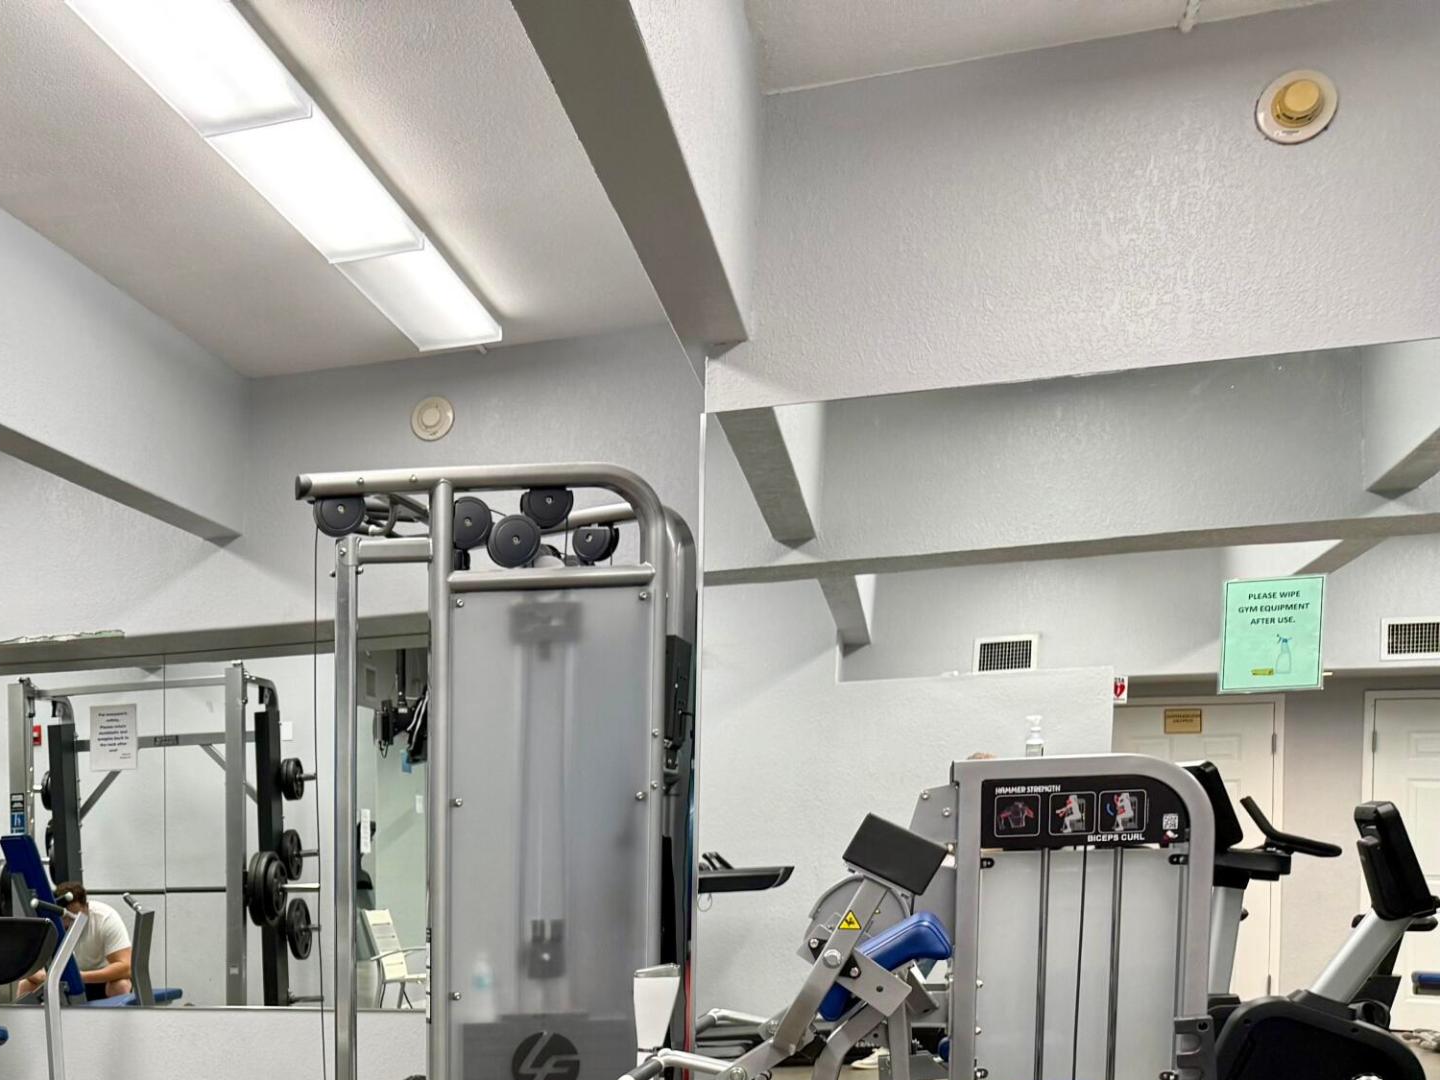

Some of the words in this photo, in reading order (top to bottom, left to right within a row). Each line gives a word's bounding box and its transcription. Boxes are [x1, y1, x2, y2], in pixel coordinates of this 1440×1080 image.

[1248, 592, 1277, 600] PLEASE
[1279, 590, 1300, 598] WIPE
[1238, 605, 1258, 613] GYM
[1260, 602, 1310, 612] EQUIPMENT
[1250, 617, 1275, 625] AFTER
[1277, 616, 1296, 624] USE.
[995, 786, 1026, 795] HAMMER
[1026, 784, 1061, 793] STRENGTH
[1087, 834, 1119, 843] BICEPS
[1121, 833, 1145, 842] CURL
